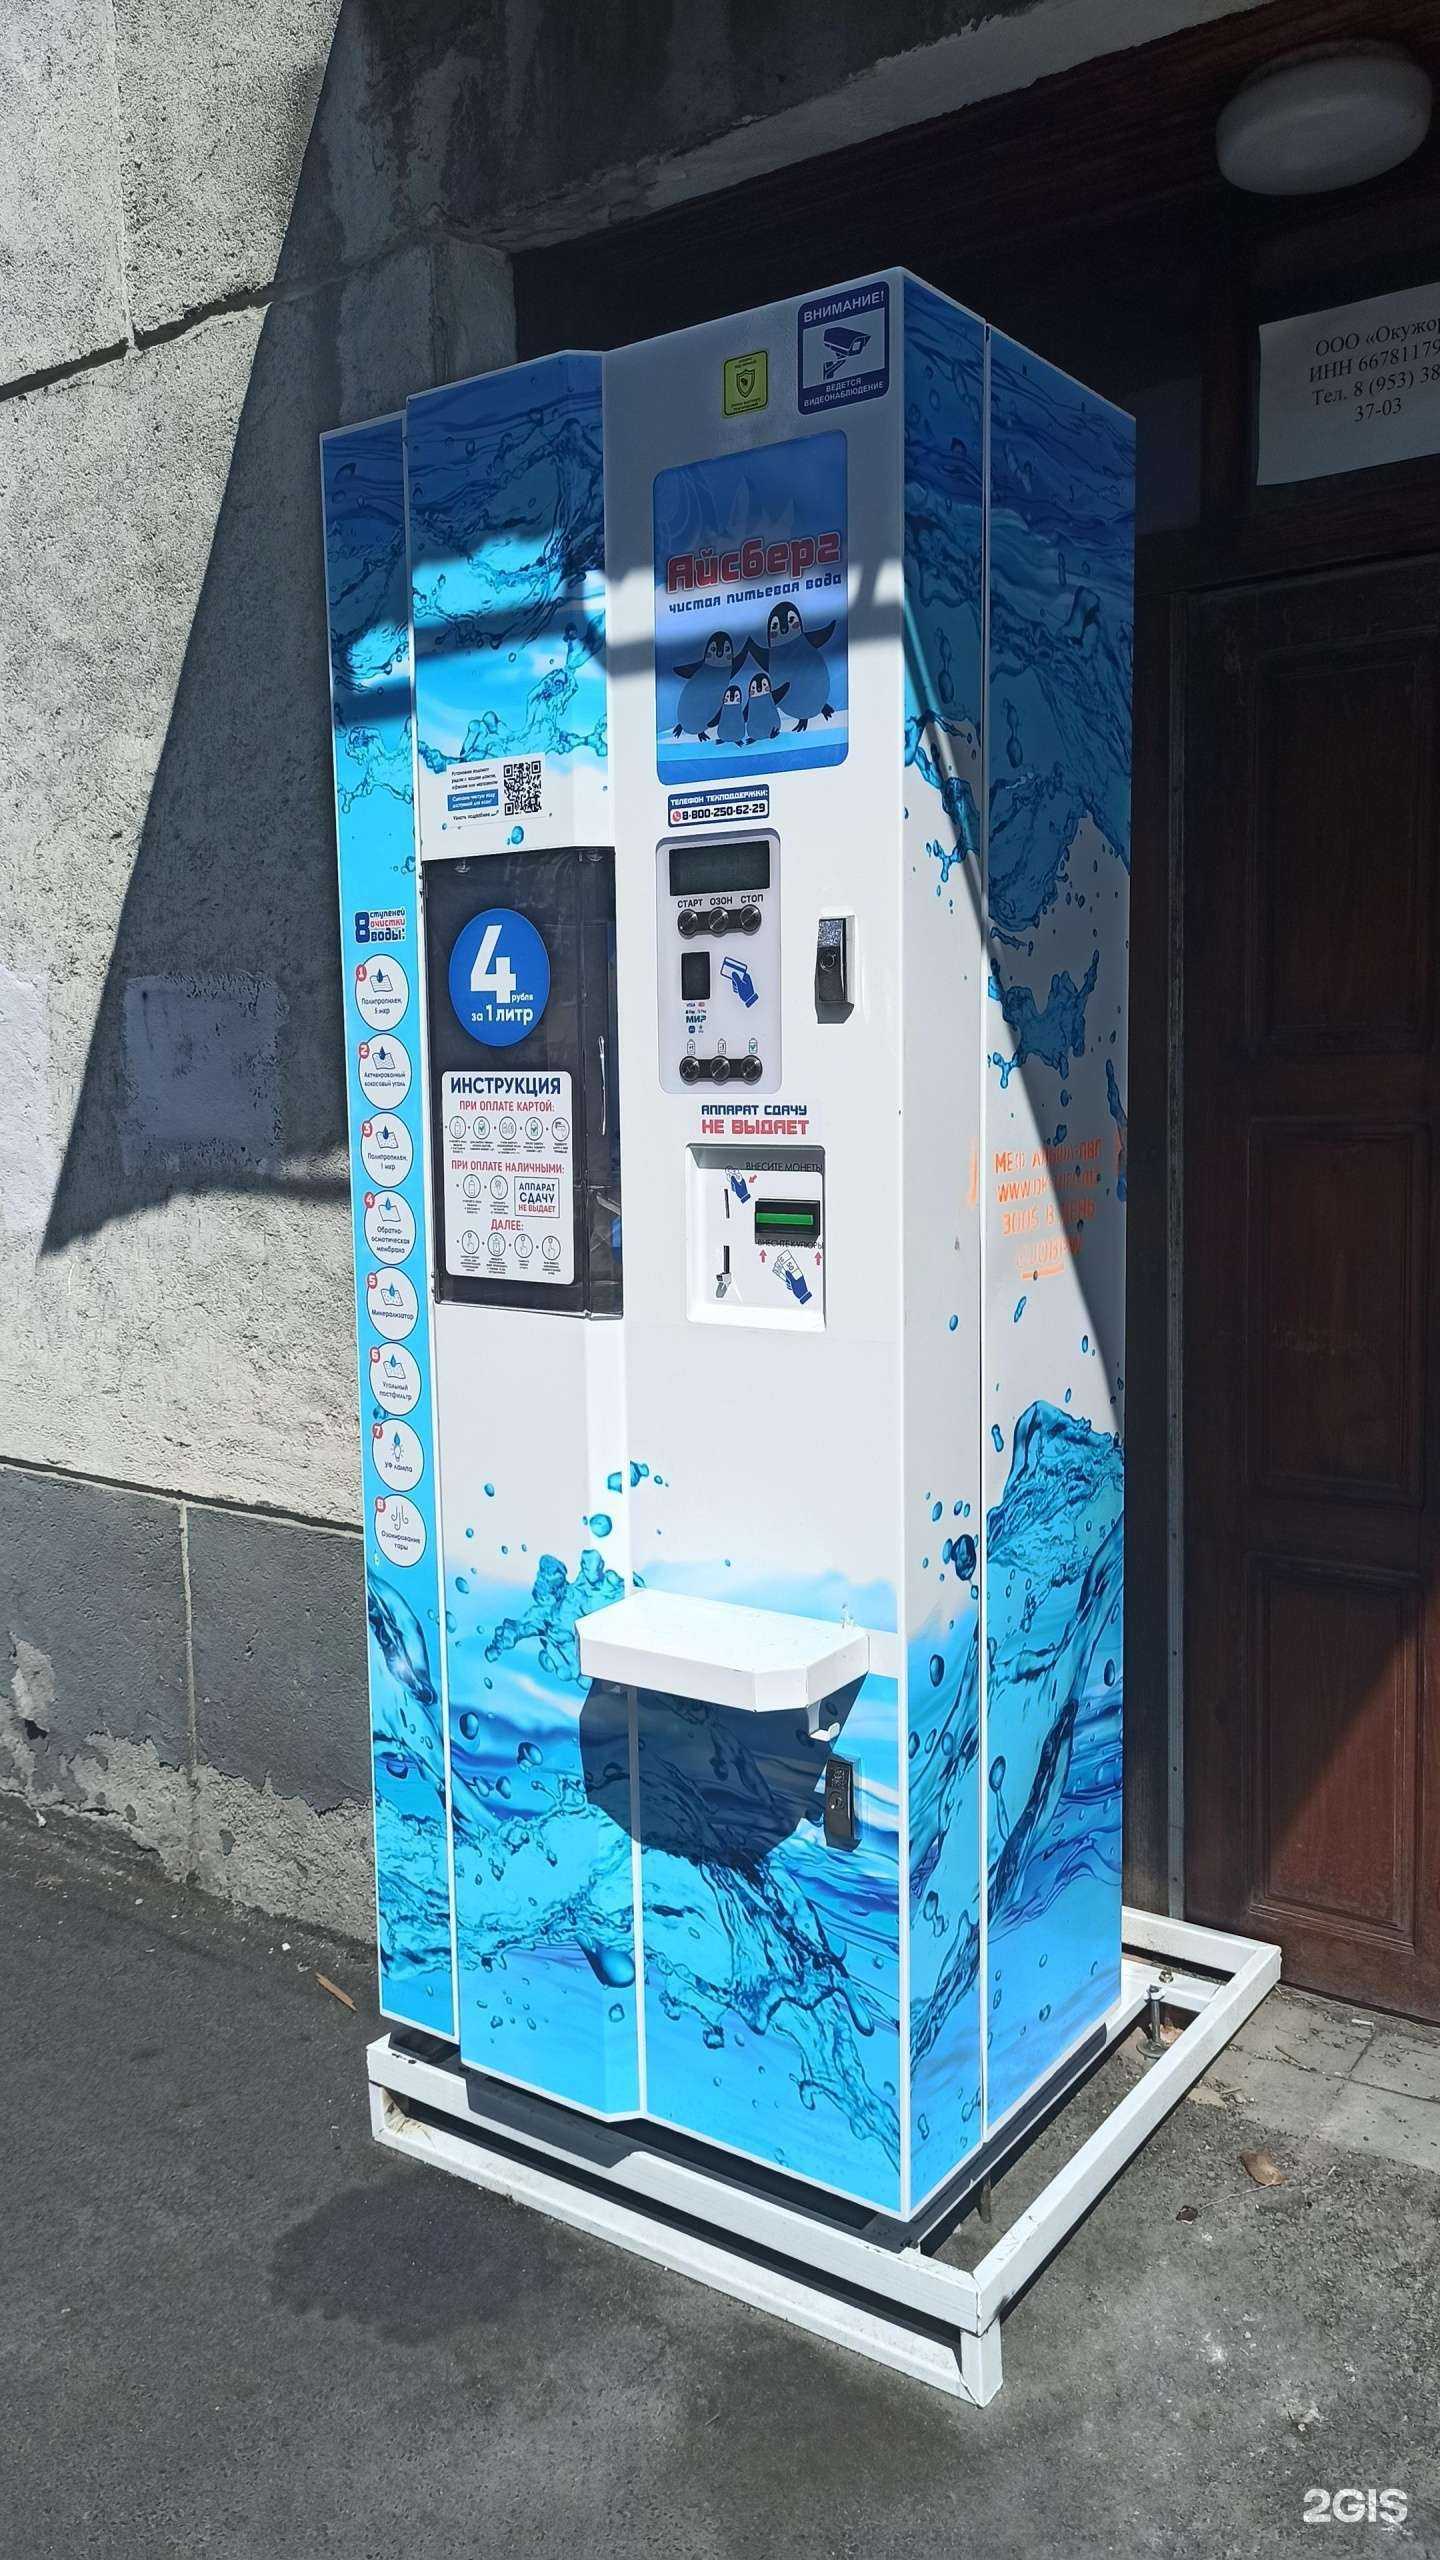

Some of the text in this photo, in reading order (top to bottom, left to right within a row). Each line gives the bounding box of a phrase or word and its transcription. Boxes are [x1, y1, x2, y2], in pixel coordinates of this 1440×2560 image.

[803, 290, 884, 323] ВНИМАНИЕ!
[1316, 333, 1360, 356] ООО
[1309, 359, 1352, 382] ИНН
[826, 377, 862, 392] ВЕДЕТСЯ
[1312, 389, 1347, 406] Тел.
[1354, 381, 1364, 397] 8
[1369, 370, 1414, 395] (953)
[804, 381, 883, 407] ВИДЕОНАБЛЮДЕНИЕ
[1354, 397, 1401, 422] 37-03
[666, 531, 841, 594] Айсберг
[669, 573, 842, 613] чистая питьевая вода
[670, 790, 768, 806] ТЕЛЕФОН ТЕХПОДДЕРЖКИ:
[682, 803, 766, 820] 8-800-250-62-29
[677, 894, 764, 908] СТАРТ ОЗОН СТОП
[370, 907, 405, 919] ступеней
[355, 911, 370, 943] 8
[370, 919, 405, 927] очистки
[371, 927, 405, 942] воды:
[470, 924, 517, 1004] 4
[471, 1005, 533, 1025] за 1 литр
[686, 1015, 706, 1023] МИР
[361, 1044, 368, 1058] 2
[451, 1077, 561, 1097] ИНСТРУКЦИЯ
[459, 1100, 555, 1112] ПРИ ОПЛАТЕ КАРТОЙ:
[701, 1104, 807, 1116] АППАРАТ СДАЧУ
[702, 1119, 810, 1135] НЕ ВЫДАЕТ
[451, 1160, 565, 1174] ПРИ ОПЛАТЕ НАЛИЧНЫМИ:
[745, 1162, 783, 1170] ВНЕСИТЕ
[519, 1182, 556, 1192] АППАРАТ
[519, 1192, 555, 1204] СДАЧУ
[518, 1204, 527, 1212] НЕ
[528, 1205, 556, 1213] ВЫДАЕТ
[490, 1219, 524, 1231] ДАЛЕЕ:
